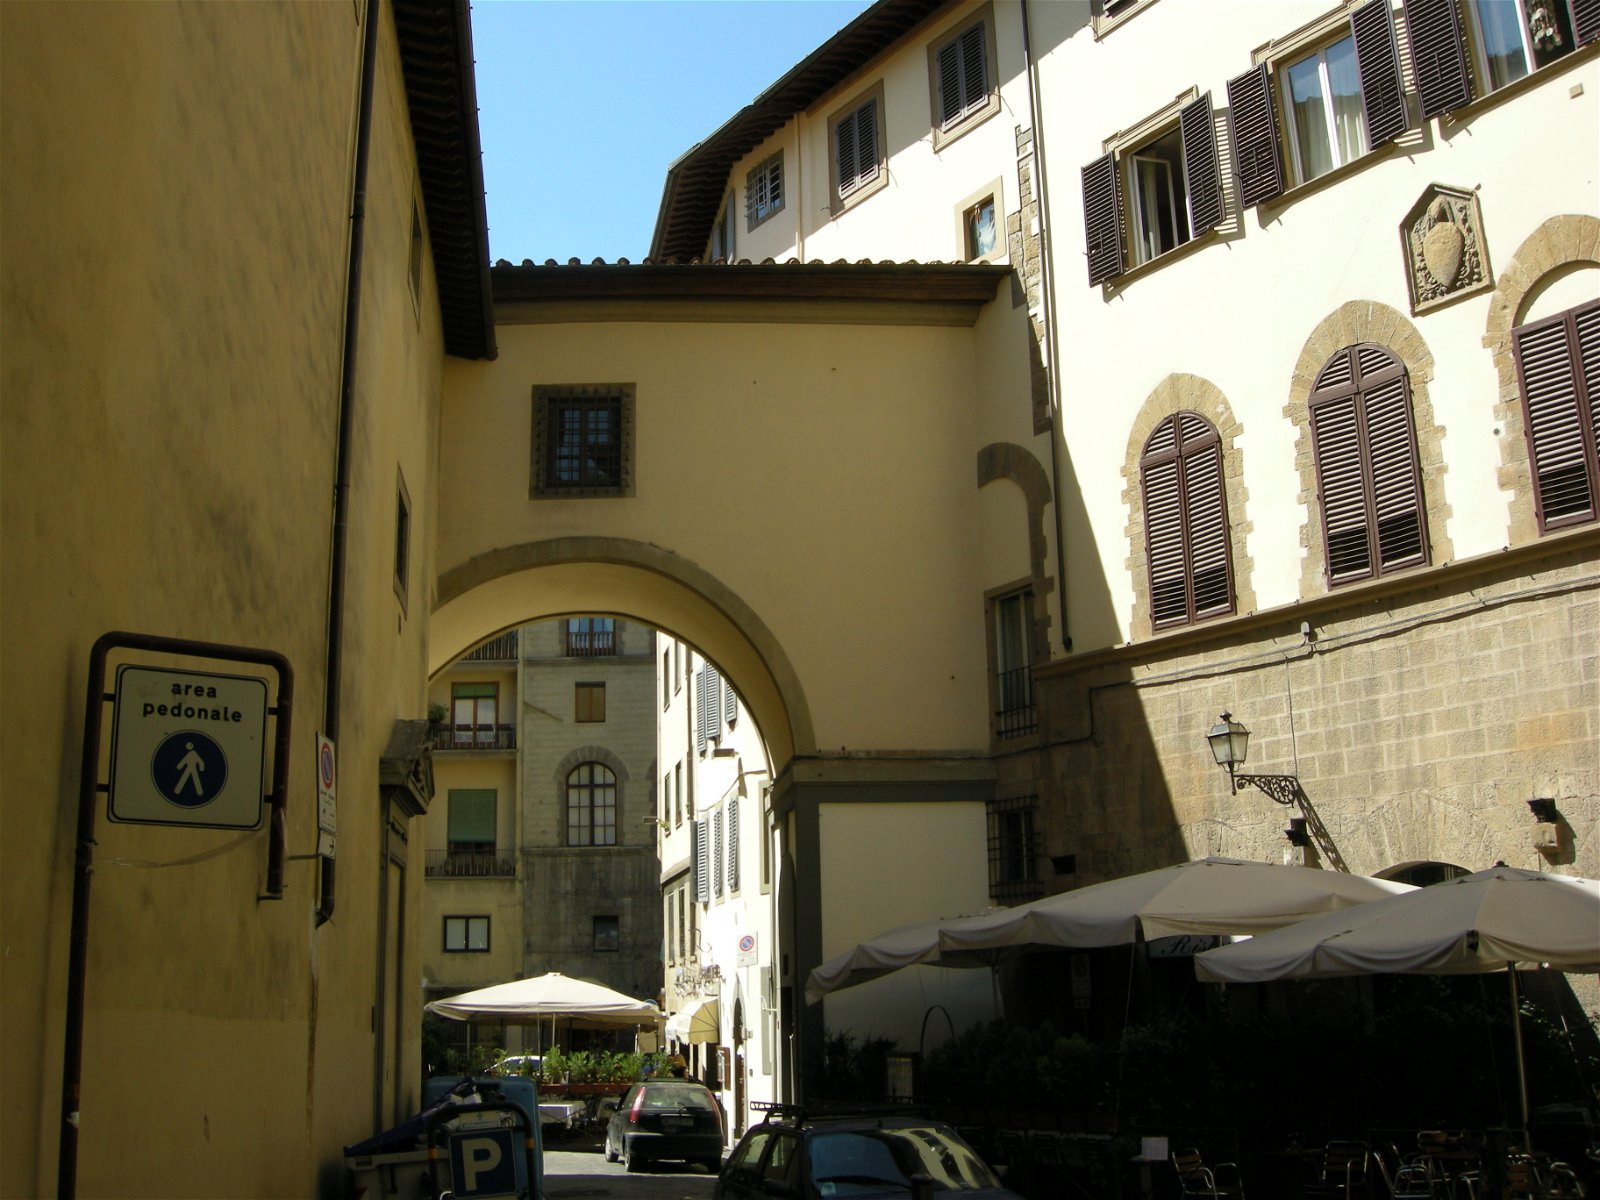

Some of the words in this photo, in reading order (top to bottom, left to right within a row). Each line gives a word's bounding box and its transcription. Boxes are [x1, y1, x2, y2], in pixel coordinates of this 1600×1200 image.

[171, 683, 217, 698] area
[143, 702, 242, 722] pedonale
[461, 1137, 502, 1191] P
